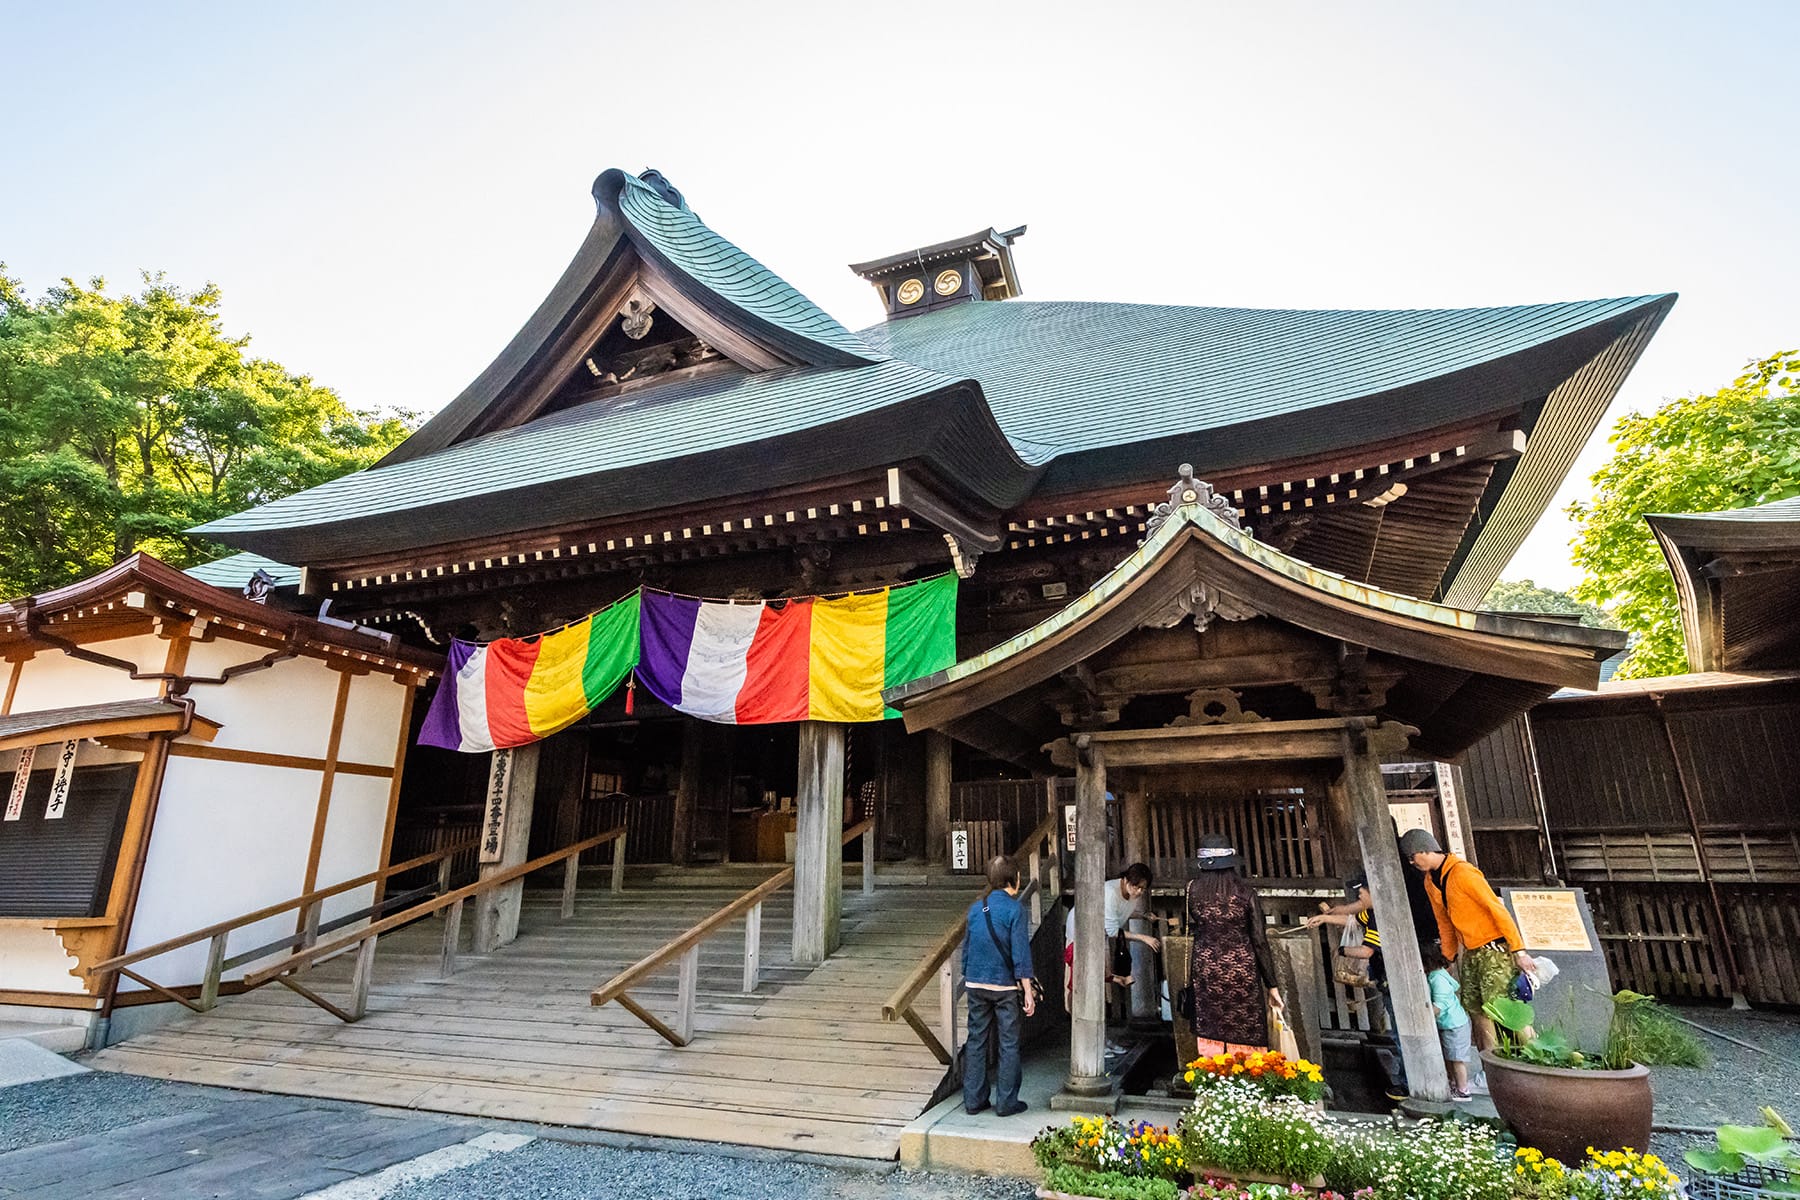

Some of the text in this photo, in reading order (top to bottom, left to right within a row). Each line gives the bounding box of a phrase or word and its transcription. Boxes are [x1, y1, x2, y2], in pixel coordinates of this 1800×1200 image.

[50, 739, 76, 812] お守り授与
[955, 834, 967, 867] 傘立て
